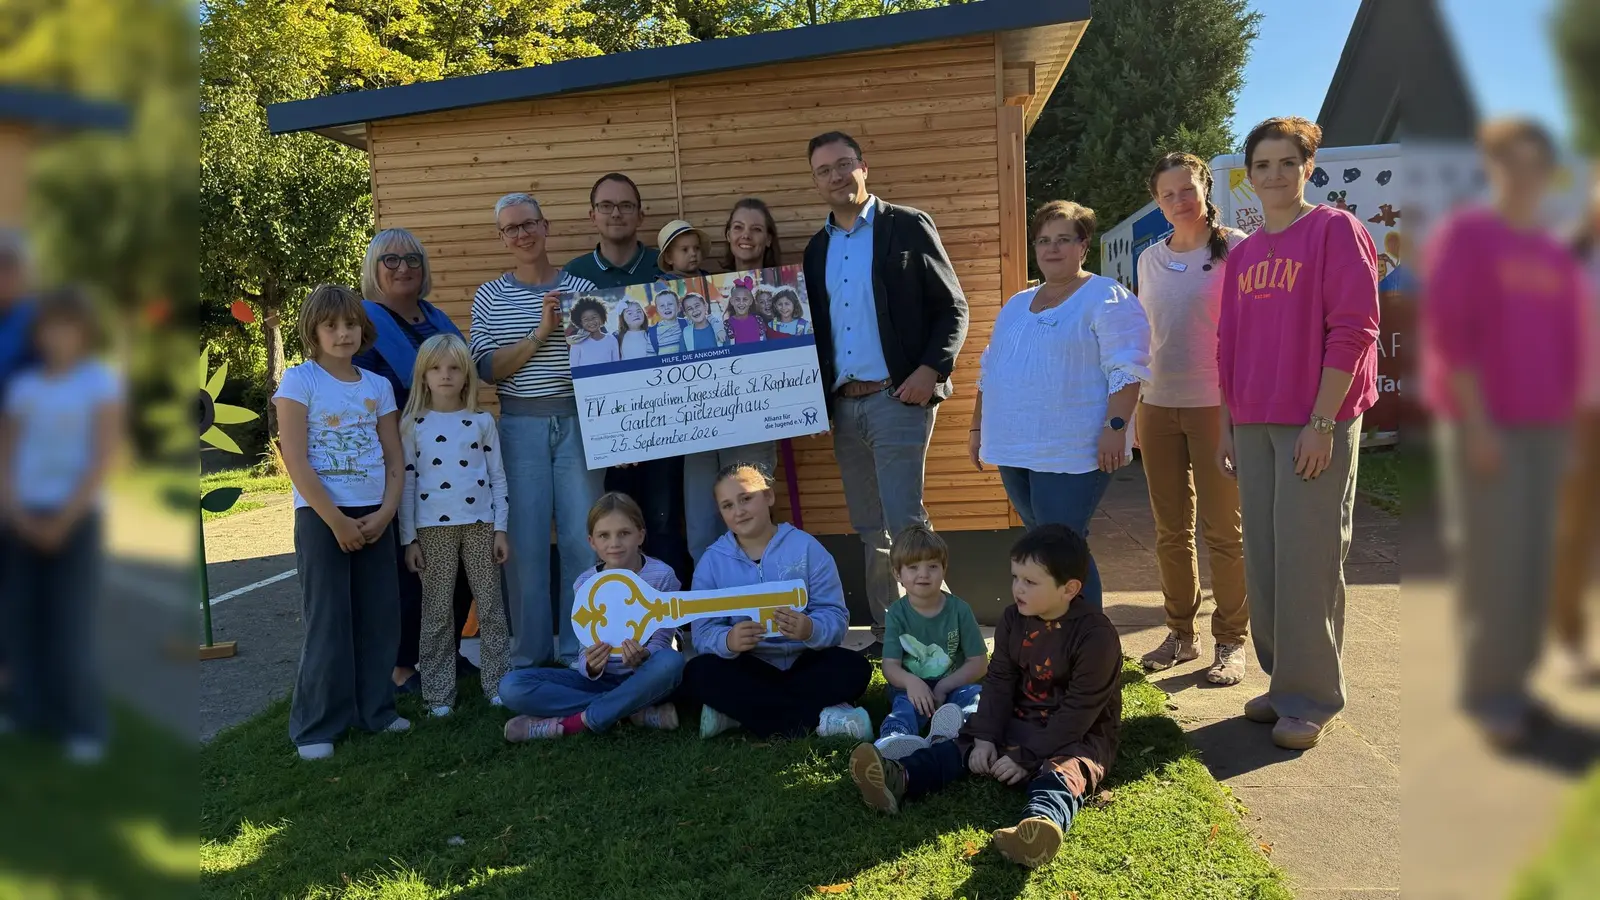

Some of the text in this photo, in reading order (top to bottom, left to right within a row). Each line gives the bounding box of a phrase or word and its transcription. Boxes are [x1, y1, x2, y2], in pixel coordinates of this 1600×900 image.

[1238, 258, 1302, 298] MOIN
[661, 348, 731, 364] HILFE, DIE ANKOMMT!
[611, 399, 627, 415] der
[631, 391, 684, 413] integrativen
[746, 377, 760, 394] St.
[761, 369, 804, 392] Raphael
[764, 415, 782, 423] Allianz
[765, 422, 774, 430] die
[774, 419, 794, 429] Jugend
[610, 426, 719, 453] 25. September 2026
